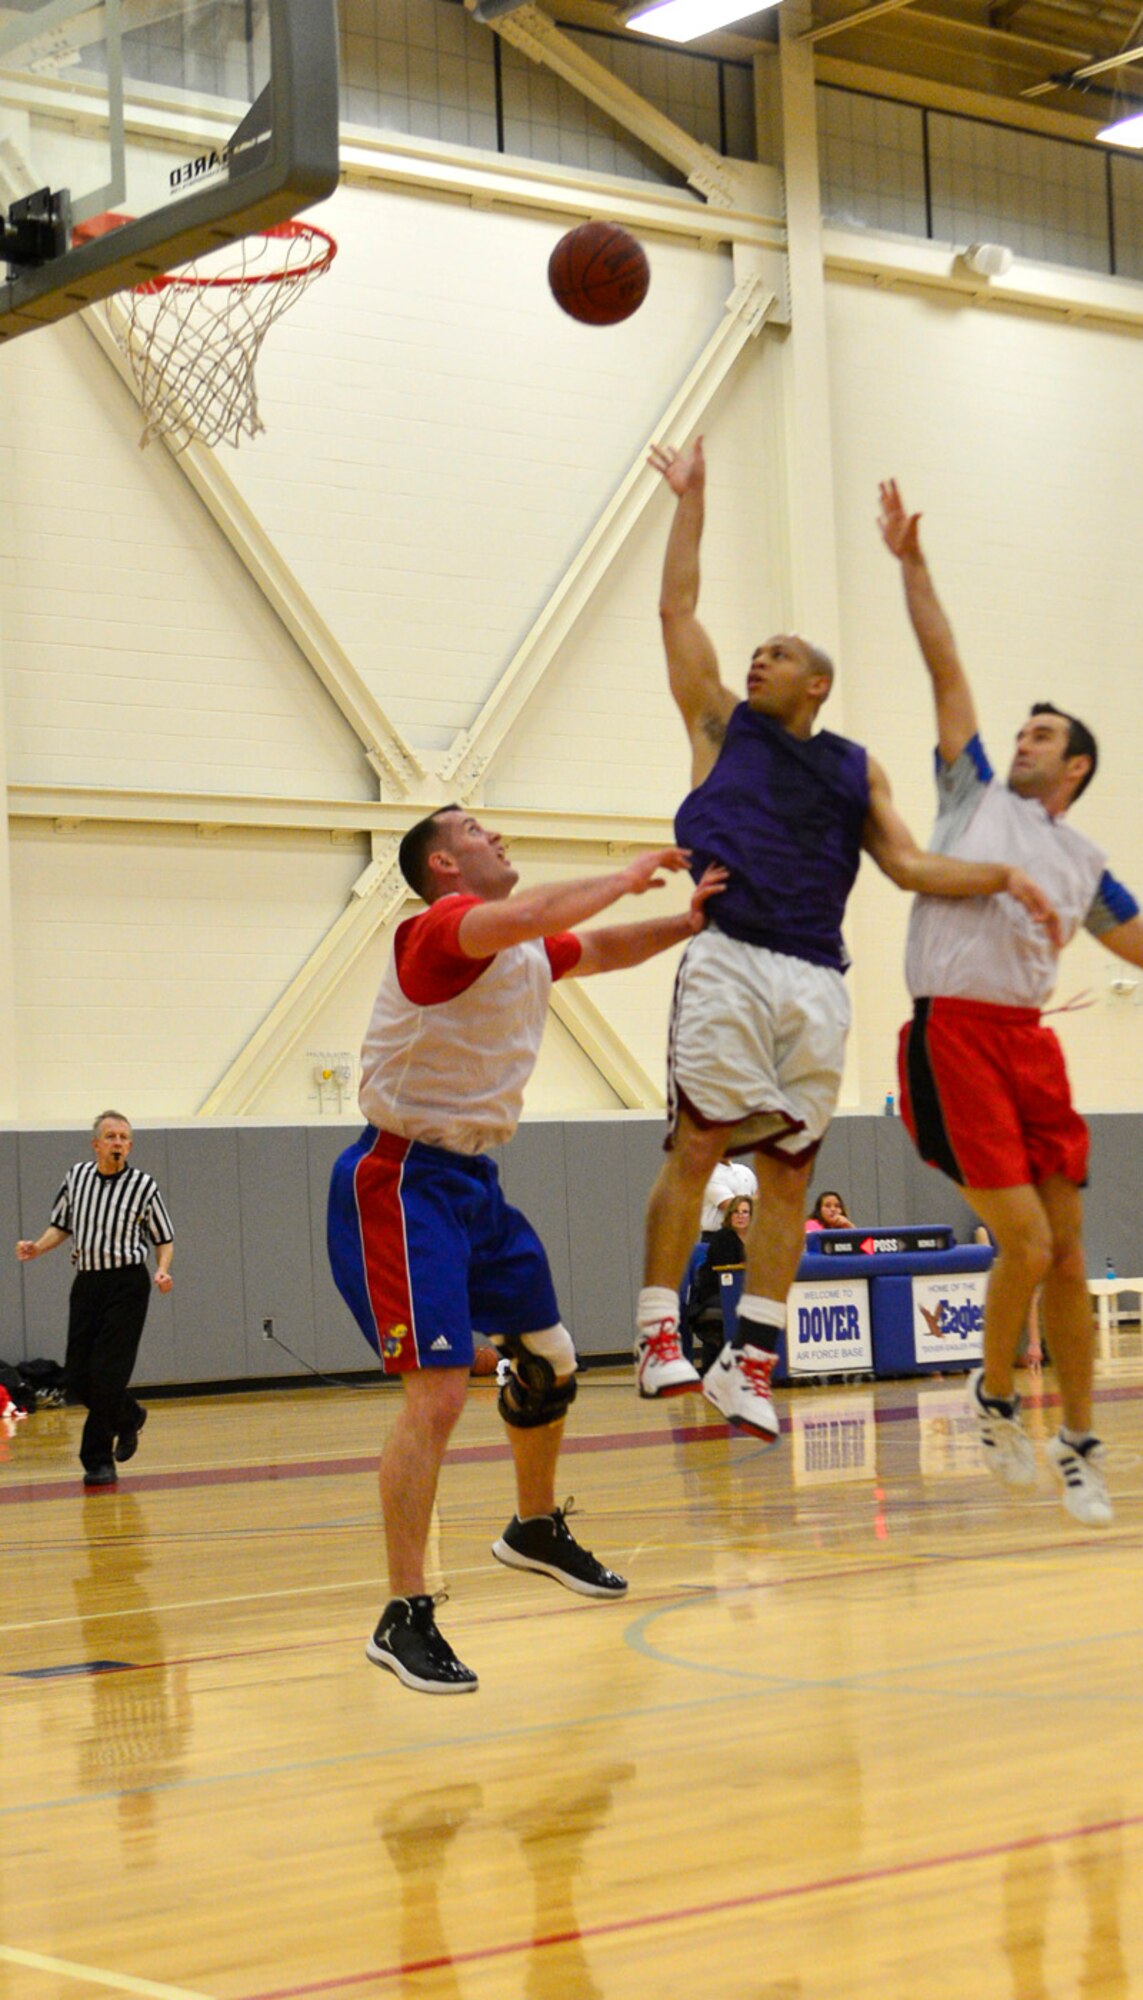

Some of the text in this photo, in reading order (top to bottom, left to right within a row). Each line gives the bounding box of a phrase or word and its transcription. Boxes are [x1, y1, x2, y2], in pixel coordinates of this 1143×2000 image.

[873, 1238, 897, 1252] POSS
[804, 1289, 853, 1299] WELCOME TO
[798, 1305, 860, 1343] DOVER
[797, 1347, 863, 1360] AIR FORCE BASE
